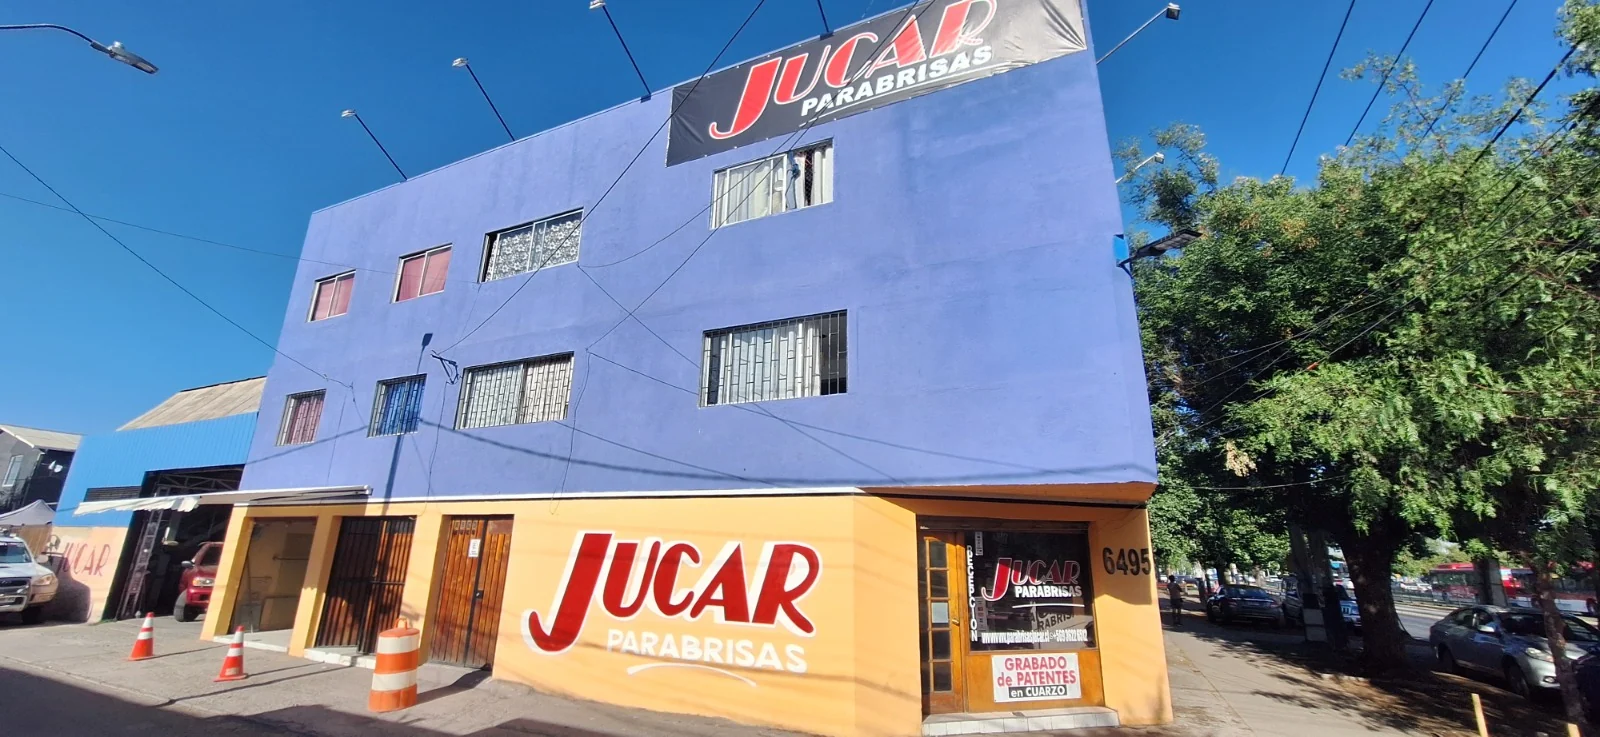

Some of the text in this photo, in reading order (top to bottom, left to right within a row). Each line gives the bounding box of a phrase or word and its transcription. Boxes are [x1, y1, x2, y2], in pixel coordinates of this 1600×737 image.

[709, 0, 997, 139] JUCAR
[801, 45, 992, 116] PARABRISAS
[981, 558, 1081, 601] JUCAR
[1103, 547, 1151, 575] 6495
[522, 530, 822, 655] JUCAR
[966, 545, 978, 641] RECEPCION
[1014, 585, 1082, 598] PARABRISAS
[607, 628, 808, 674] PARABRISAS
[1005, 656, 1067, 671] GRABADO
[997, 670, 1077, 687] de PATENTES
[1011, 686, 1066, 698] en CUARZO
